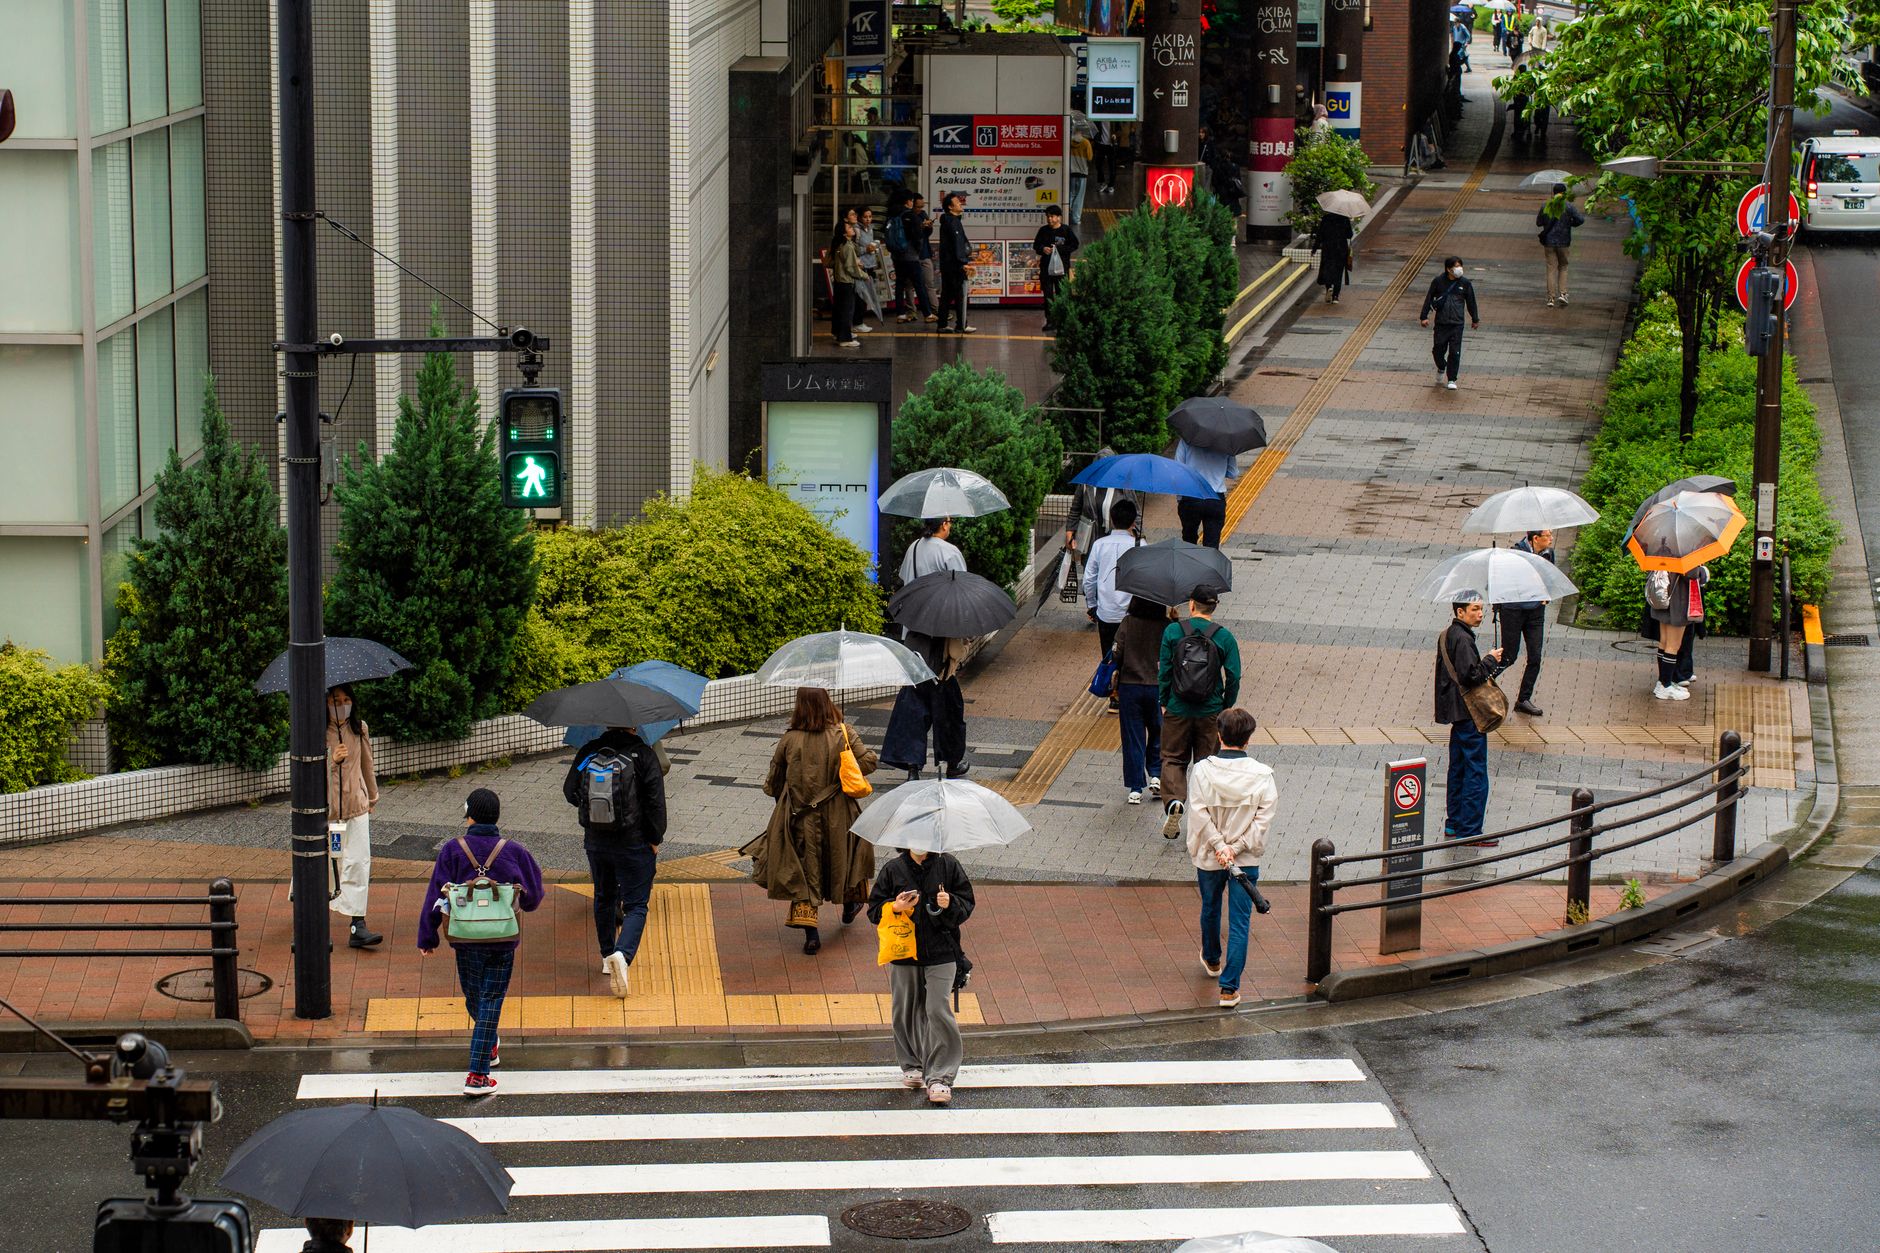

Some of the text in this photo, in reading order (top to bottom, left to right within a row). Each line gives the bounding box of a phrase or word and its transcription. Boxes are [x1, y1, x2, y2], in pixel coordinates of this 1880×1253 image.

[1256, 6, 1292, 17] AKIBA
[852, 10, 878, 33] TX
[1152, 34, 1195, 47] AKIBA
[1152, 47, 1195, 67] TOLIM
[1327, 98, 1350, 112] GU
[933, 124, 969, 143] TX
[1000, 124, 1057, 139] 秋葉原駅
[979, 133, 993, 145] 01
[935, 165, 949, 174] As
[951, 165, 978, 177] quick
[994, 164, 1002, 174] 4
[1004, 166, 1044, 175] minutes
[1046, 166, 1057, 175] to
[935, 176, 1022, 185] Asakusa Station!!
[1040, 192, 1053, 200] A1
[787, 373, 866, 391] レム秋葉原
